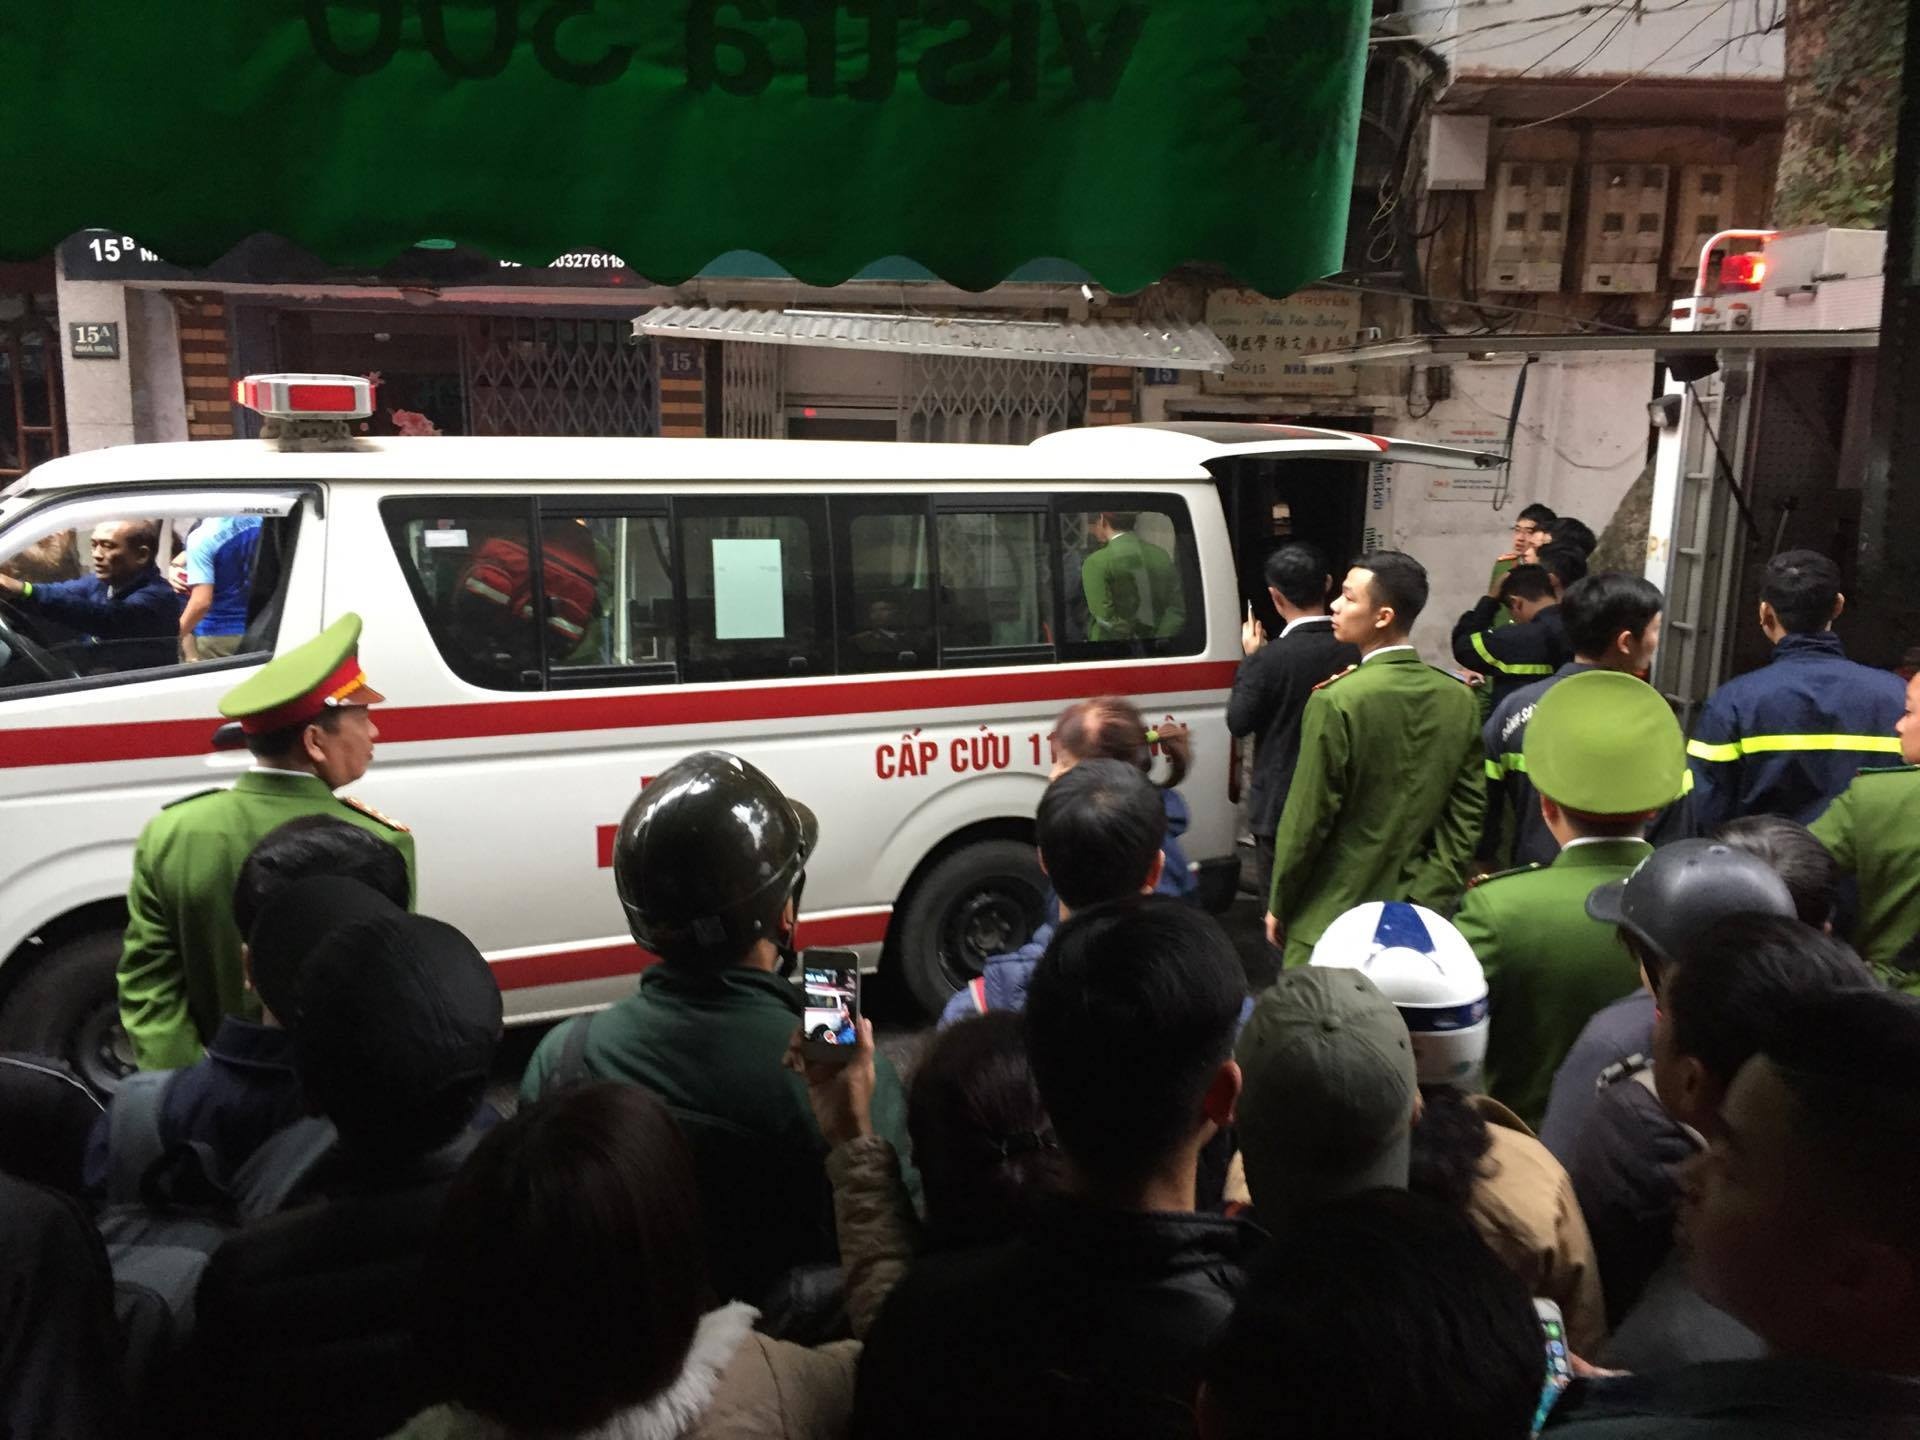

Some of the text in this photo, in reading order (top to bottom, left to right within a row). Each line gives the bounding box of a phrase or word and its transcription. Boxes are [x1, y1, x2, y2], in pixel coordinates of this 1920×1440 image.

[89, 236, 135, 262] 15B
[76, 326, 110, 344] 15A
[672, 352, 690, 371] 15
[876, 724, 1057, 780] CẤP CỨU 11
